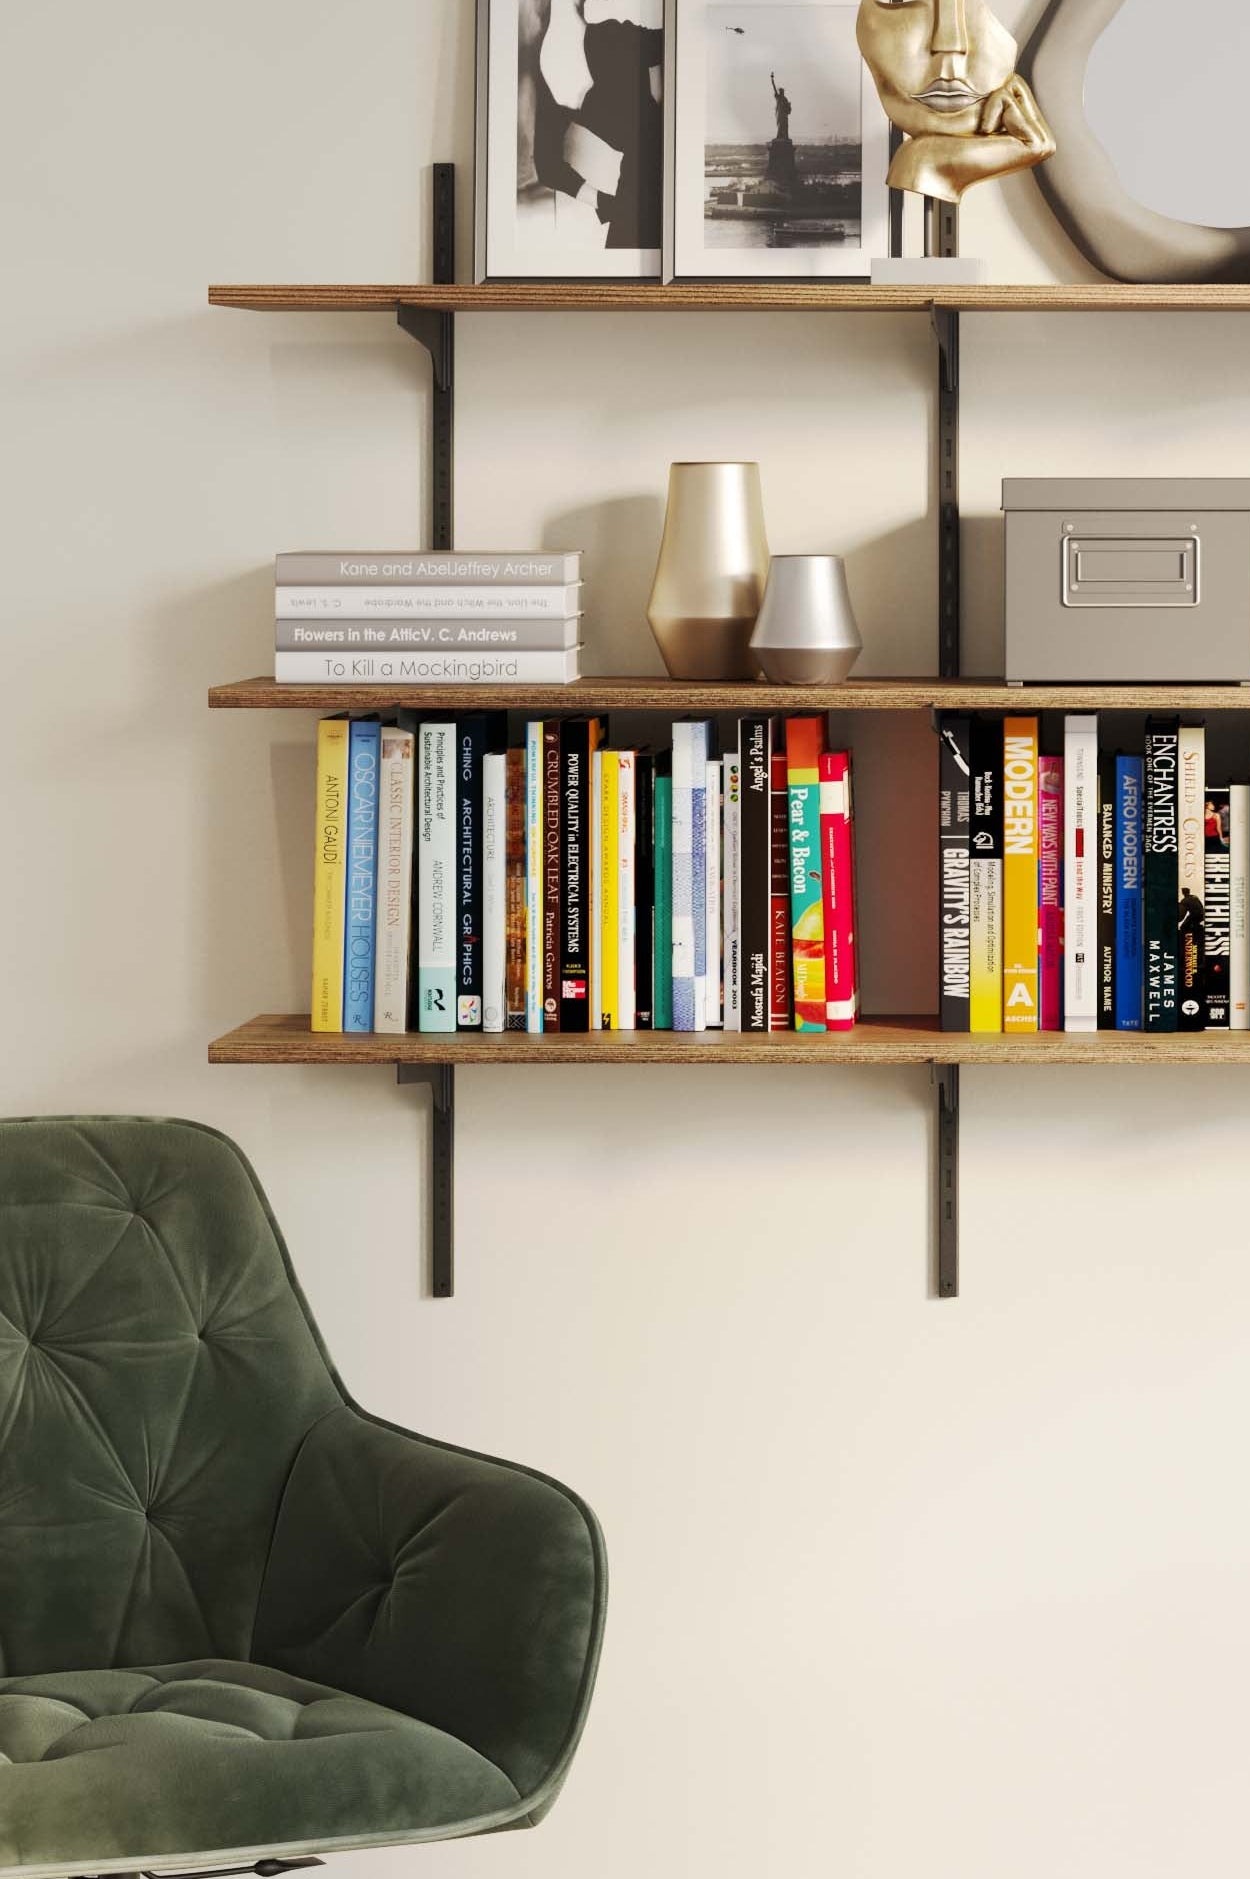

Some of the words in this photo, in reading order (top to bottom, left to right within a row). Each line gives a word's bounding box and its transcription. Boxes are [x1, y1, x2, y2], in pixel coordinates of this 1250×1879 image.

[340, 562, 378, 576] Kane
[382, 562, 412, 576] and
[503, 562, 553, 576] Archer
[294, 627, 345, 641] Flowers
[348, 627, 362, 641] in
[364, 627, 386, 641] the
[438, 627, 454, 641] C.
[457, 627, 518, 641] Andrews
[324, 659, 346, 676] To
[352, 659, 375, 676] Kill
[381, 664, 393, 676] a
[400, 659, 518, 680] Mockingbird
[423, 732, 433, 770] Sustainable
[435, 732, 447, 764] Principles
[463, 736, 472, 781] CHING
[749, 724, 766, 755] Psalms
[351, 753, 376, 821] OSCAR
[387, 762, 402, 814] CLASSIC
[436, 766, 446, 777] and
[547, 750, 559, 828] CRUMBLED
[567, 753, 579, 787] POWER
[749, 756, 766, 792] Angel's
[1147, 774, 1153, 785] OF
[323, 775, 339, 822] ANTONI
[423, 772, 433, 816] Architectural
[436, 780, 446, 811] Practices
[566, 789, 579, 832] QUALITY
[790, 787, 811, 825] Pear
[941, 791, 951, 826] PYNCHON
[957, 791, 969, 822] THOMAS
[1005, 736, 1034, 855] MODERN
[1042, 800, 1058, 822] NEW
[1123, 775, 1137, 818] AFRO
[1152, 735, 1178, 853] ENCHANTRESS
[423, 818, 433, 842] Design
[436, 812, 447, 820] of
[486, 796, 495, 861] ARCHITECTURE
[792, 829, 809, 841] &
[1042, 823, 1058, 849] WAYS
[1102, 803, 1113, 858] BALANCED
[387, 817, 402, 875] INTERIOR
[463, 798, 472, 905] ARCHITECTURAL
[547, 831, 559, 864] OAK
[1042, 850, 1058, 876] WITH
[1123, 821, 1137, 889] MODERN
[350, 827, 375, 921] NIEMEYER
[432, 860, 443, 900] ANDREW
[547, 868, 559, 903] LEAF
[567, 844, 579, 905] ELECTRICAL
[792, 847, 811, 894] Bacon
[943, 848, 969, 925] GRAVITY'S
[1102, 863, 1113, 914] MINISTRY
[387, 880, 402, 926] DESIGN
[1042, 878, 1058, 907] PAINT
[432, 902, 443, 952] CORNWALL
[545, 911, 556, 949] Patricia
[567, 907, 579, 952] SYSTEMS
[775, 910, 785, 948] KATE
[349, 926, 372, 1002] HOUSES
[463, 914, 480, 985] GRAPHICS
[545, 952, 556, 989] Gavros
[943, 928, 969, 998] RAINBOW
[1103, 946, 1112, 982] AUTHOR
[1185, 932, 1193, 988] UNDERWOOD
[775, 951, 785, 1004] BEATON
[1103, 986, 1112, 1011] NAME
[1149, 940, 1160, 1022] MAXWELL
[1164, 952, 1174, 1009] JAMES
